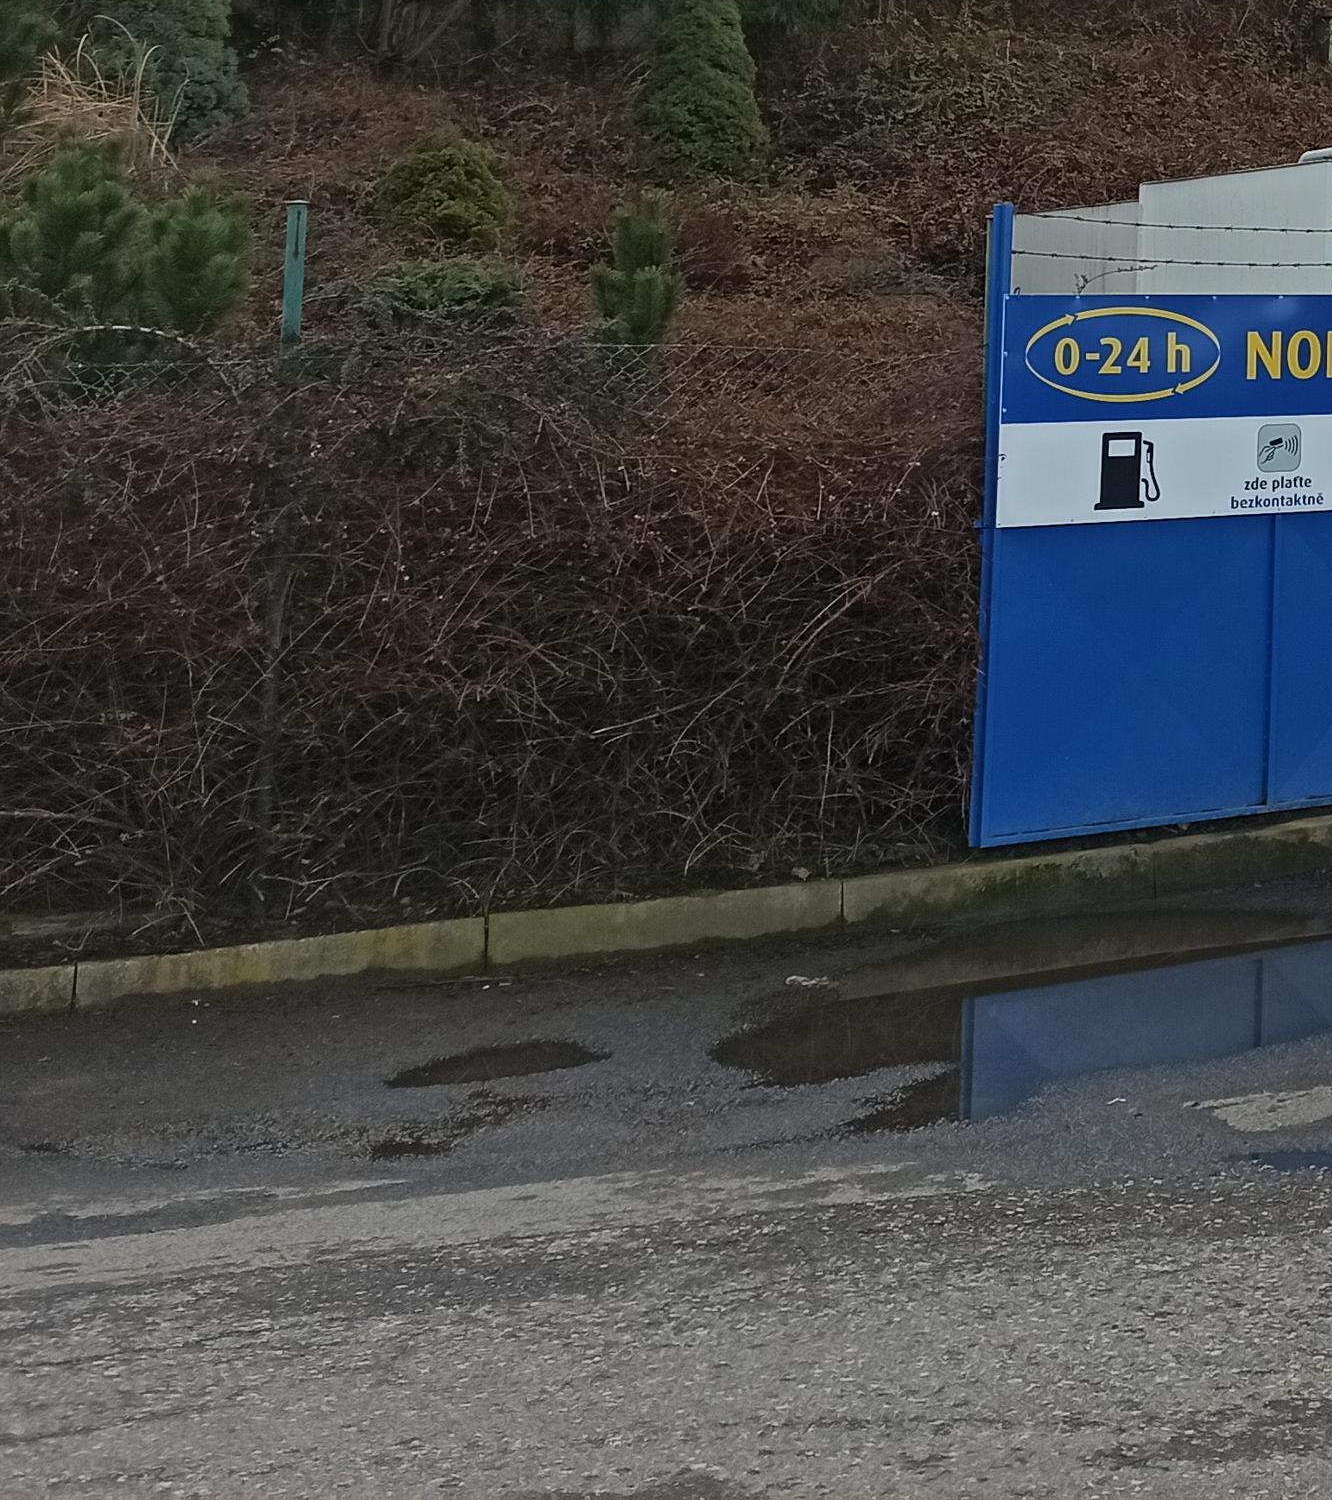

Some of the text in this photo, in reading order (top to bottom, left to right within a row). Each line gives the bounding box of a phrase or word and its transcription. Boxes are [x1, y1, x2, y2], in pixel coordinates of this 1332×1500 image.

[1053, 331, 1191, 376] 0-24 h
[1243, 475, 1312, 492] zde plaťte
[1230, 493, 1324, 509] bezkontaktně
